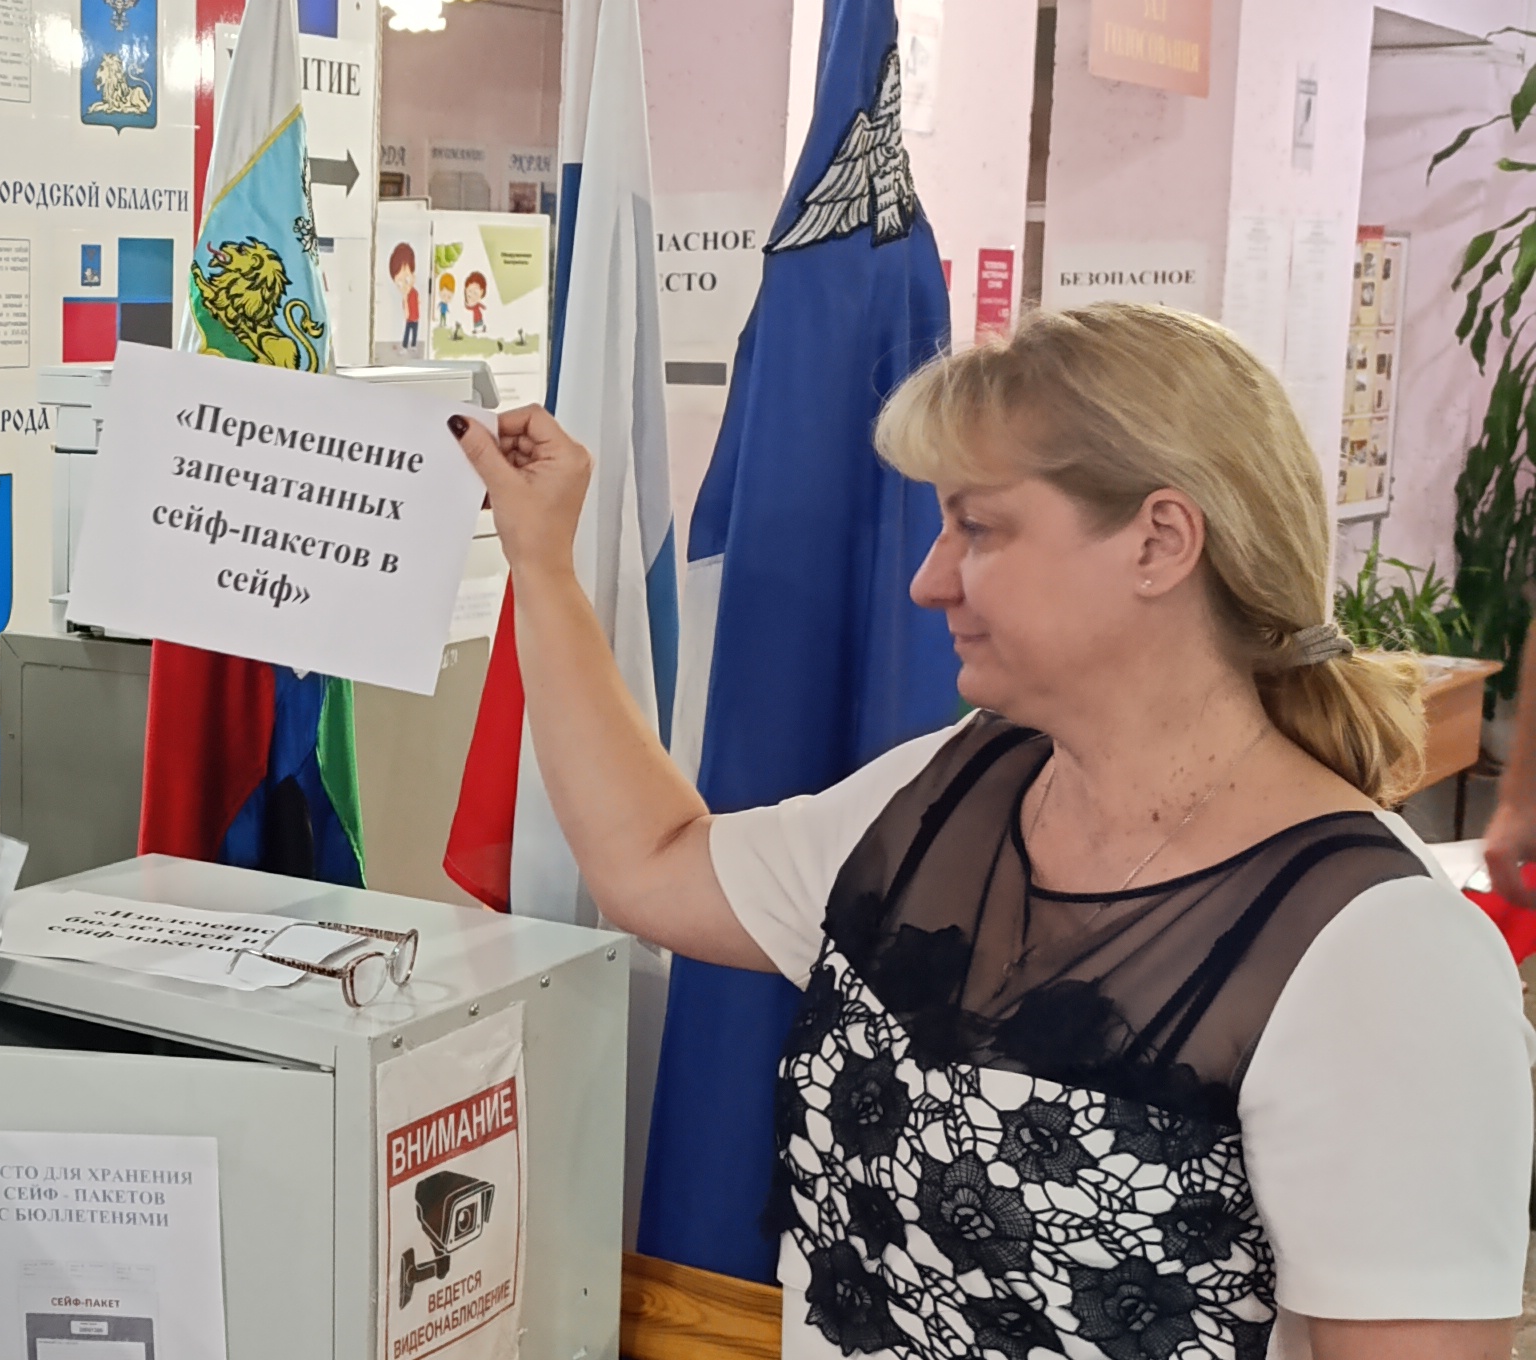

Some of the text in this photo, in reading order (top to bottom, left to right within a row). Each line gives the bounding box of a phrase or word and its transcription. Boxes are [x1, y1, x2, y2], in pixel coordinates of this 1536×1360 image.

[105, 188, 189, 213] ОБЛАСТИ
[661, 271, 717, 293] СТО
[1060, 269, 1196, 287] БЕЗОПАСНОЕ
[176, 403, 424, 474] «Перемещение
[171, 456, 404, 520] запечатанных
[152, 504, 400, 575] сейф-пакетов в
[216, 566, 312, 609] сейф»
[64, 916, 233, 941] бюллетеней
[94, 910, 275, 935] «Извлечение
[391, 1086, 513, 1178] ВНИМАНИЕ
[43, 1166, 81, 1182] ДЛЯ
[87, 1167, 193, 1186] ХРАНЕНИЯ
[3, 1184, 59, 1202] СЕЙФ
[73, 1188, 166, 1206] ПАКЕТОВ
[15, 1208, 169, 1228] БЮЛЛЕТЕНЯМИ
[51, 1296, 121, 1309] СЕЙФ-ПАКЕТ
[427, 1269, 482, 1314] ВЕДЕТСЯ
[393, 1279, 511, 1360] ВИДЕОНАБЛЮДЕНИЕ
